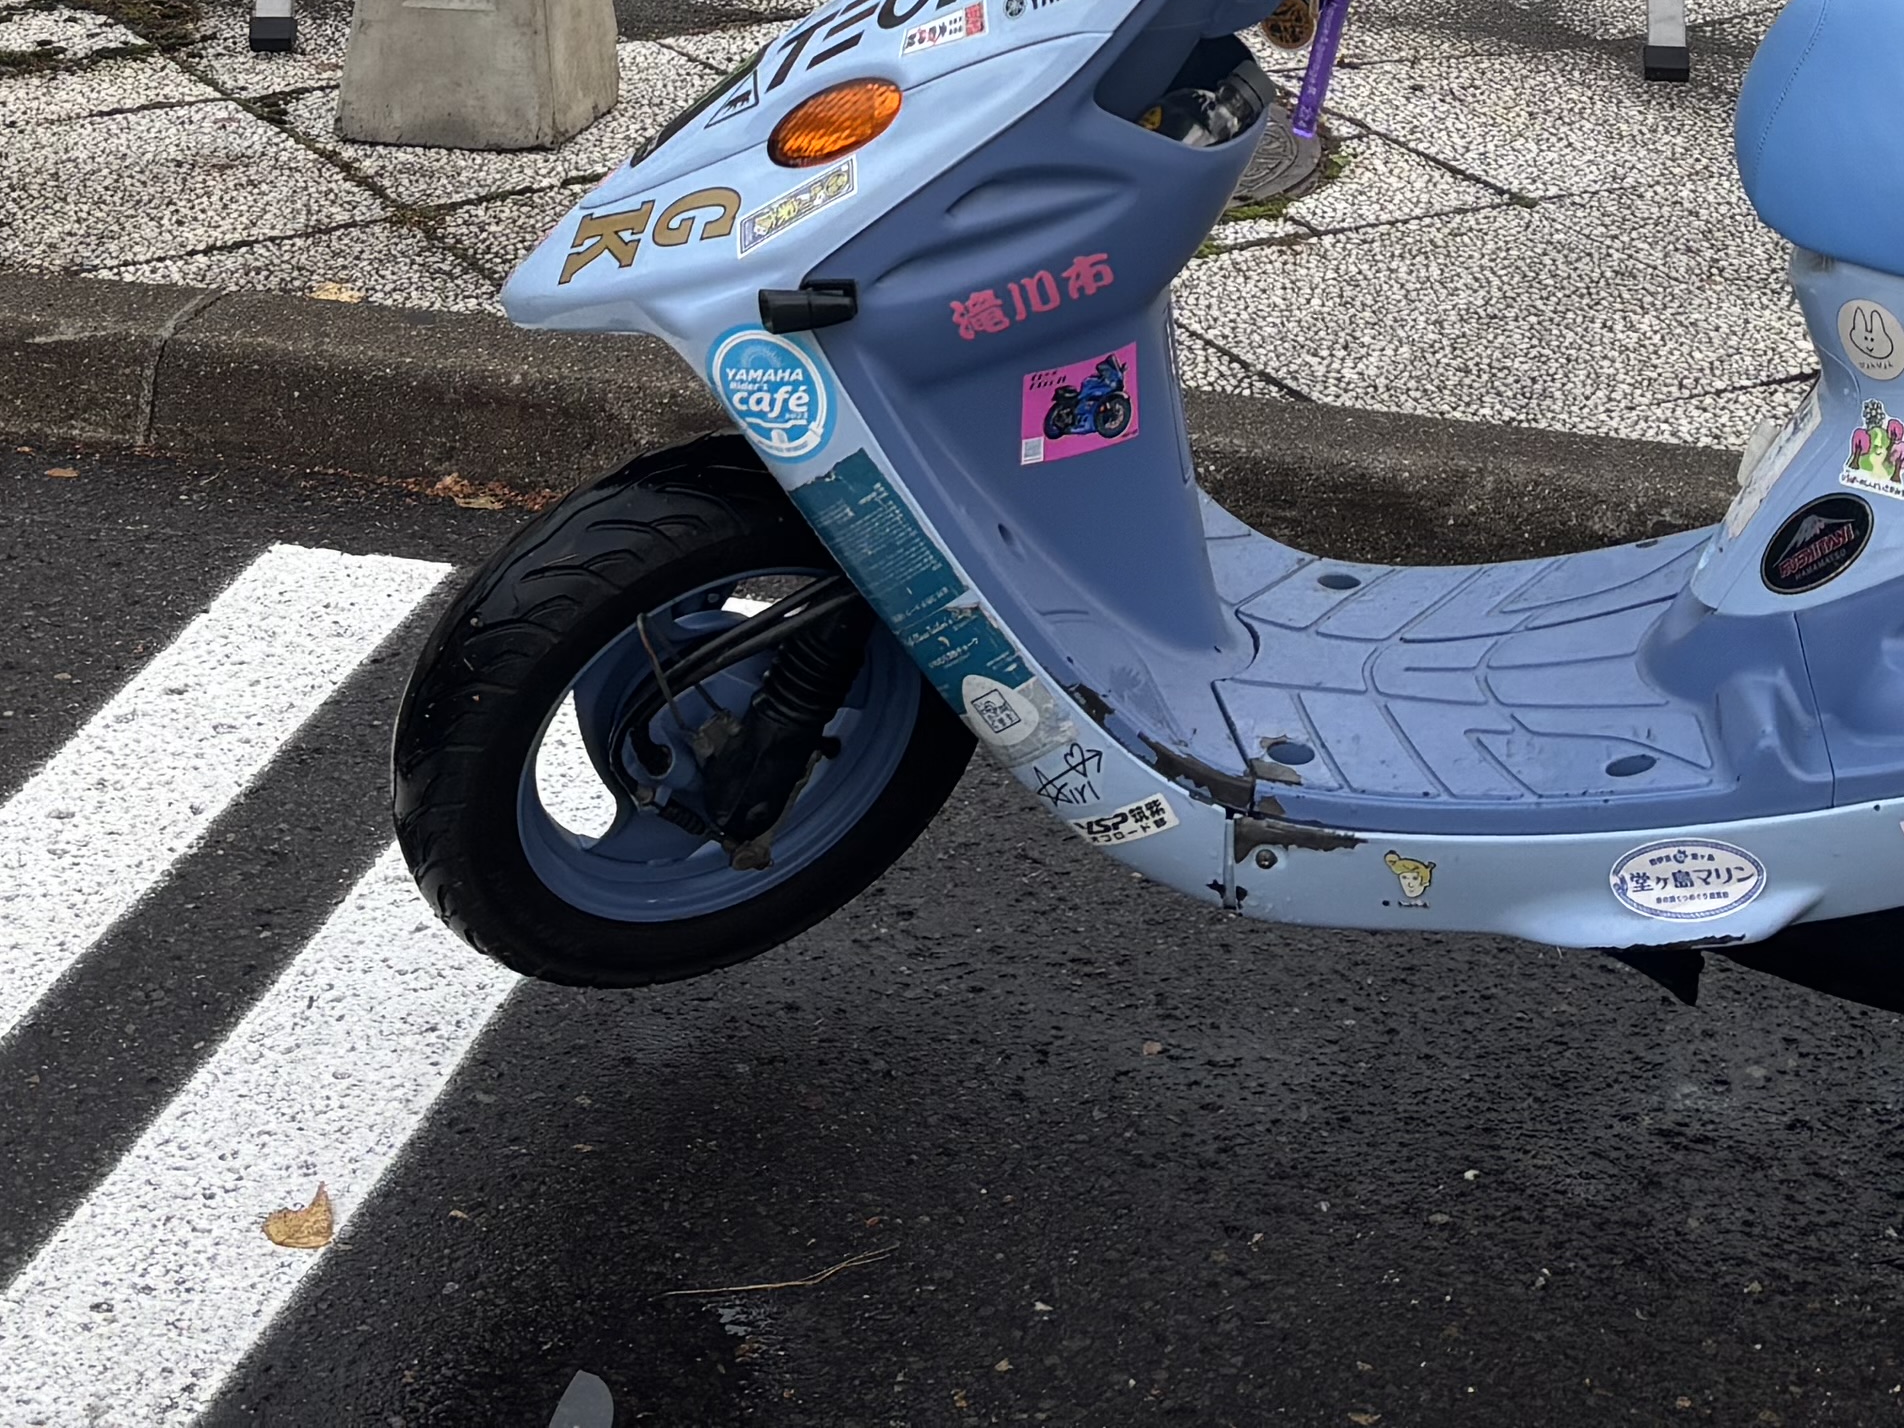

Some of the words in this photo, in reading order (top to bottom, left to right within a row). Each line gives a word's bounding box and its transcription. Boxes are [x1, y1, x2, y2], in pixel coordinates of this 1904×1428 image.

[949, 252, 1115, 340] 滝川市
[726, 367, 803, 383] YAMAHA
[732, 384, 810, 420] café
[1629, 866, 1754, 893] 堂ヶ島マリン
